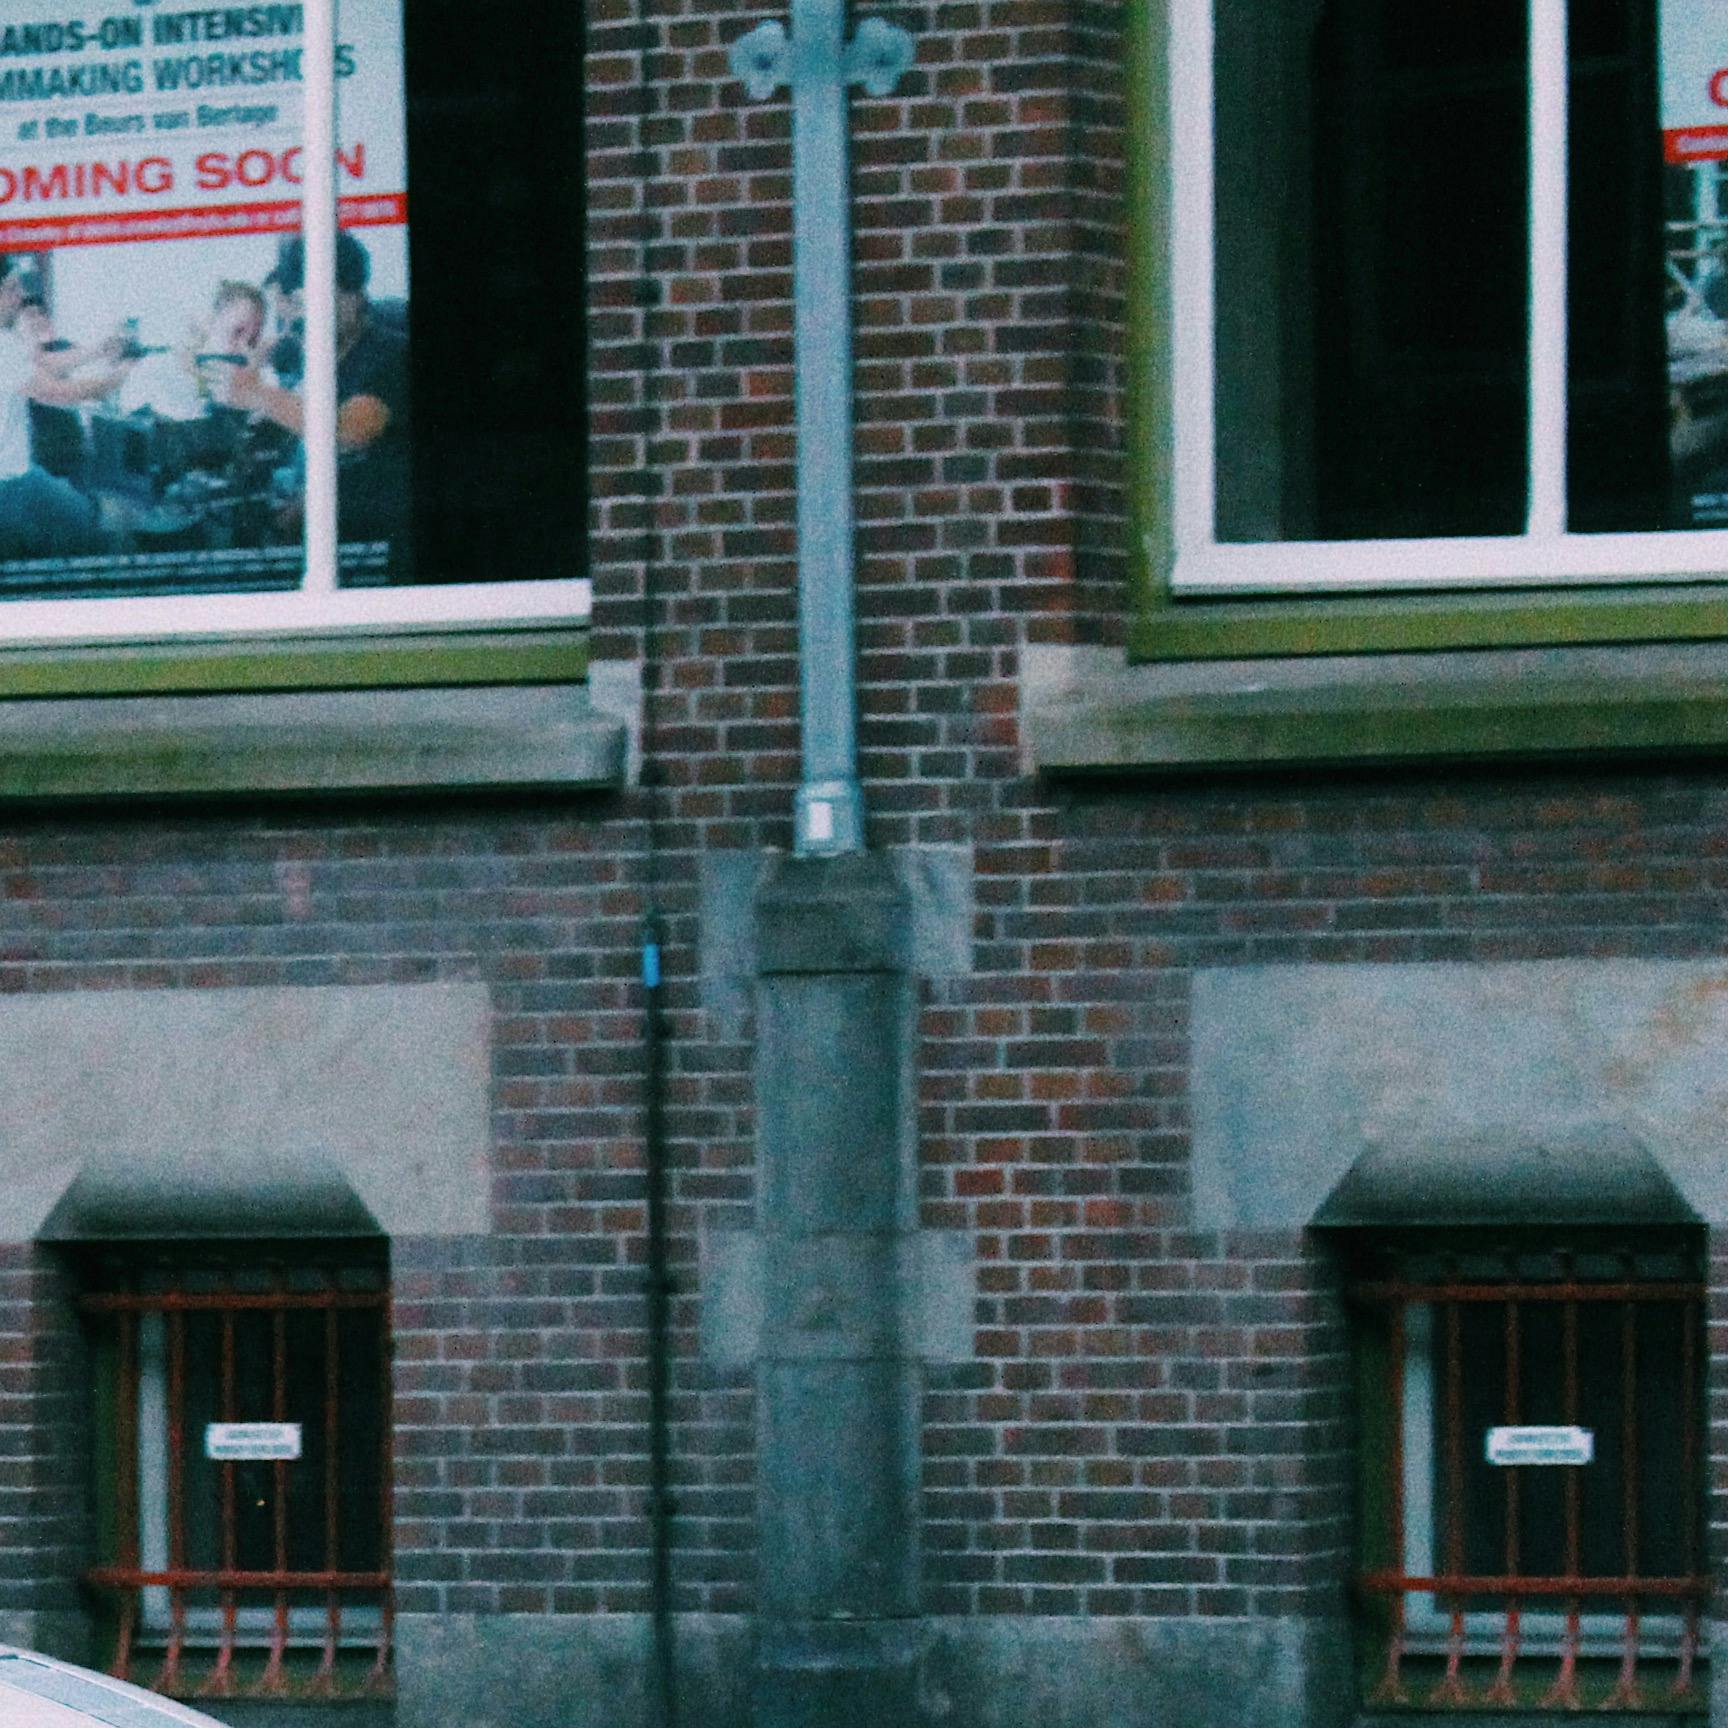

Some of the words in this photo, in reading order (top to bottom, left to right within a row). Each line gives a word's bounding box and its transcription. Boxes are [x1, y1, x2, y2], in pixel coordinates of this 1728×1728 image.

[153, 4, 304, 46] INTENSIV
[153, 44, 357, 92] WORKSHS
[45, 116, 79, 139] the
